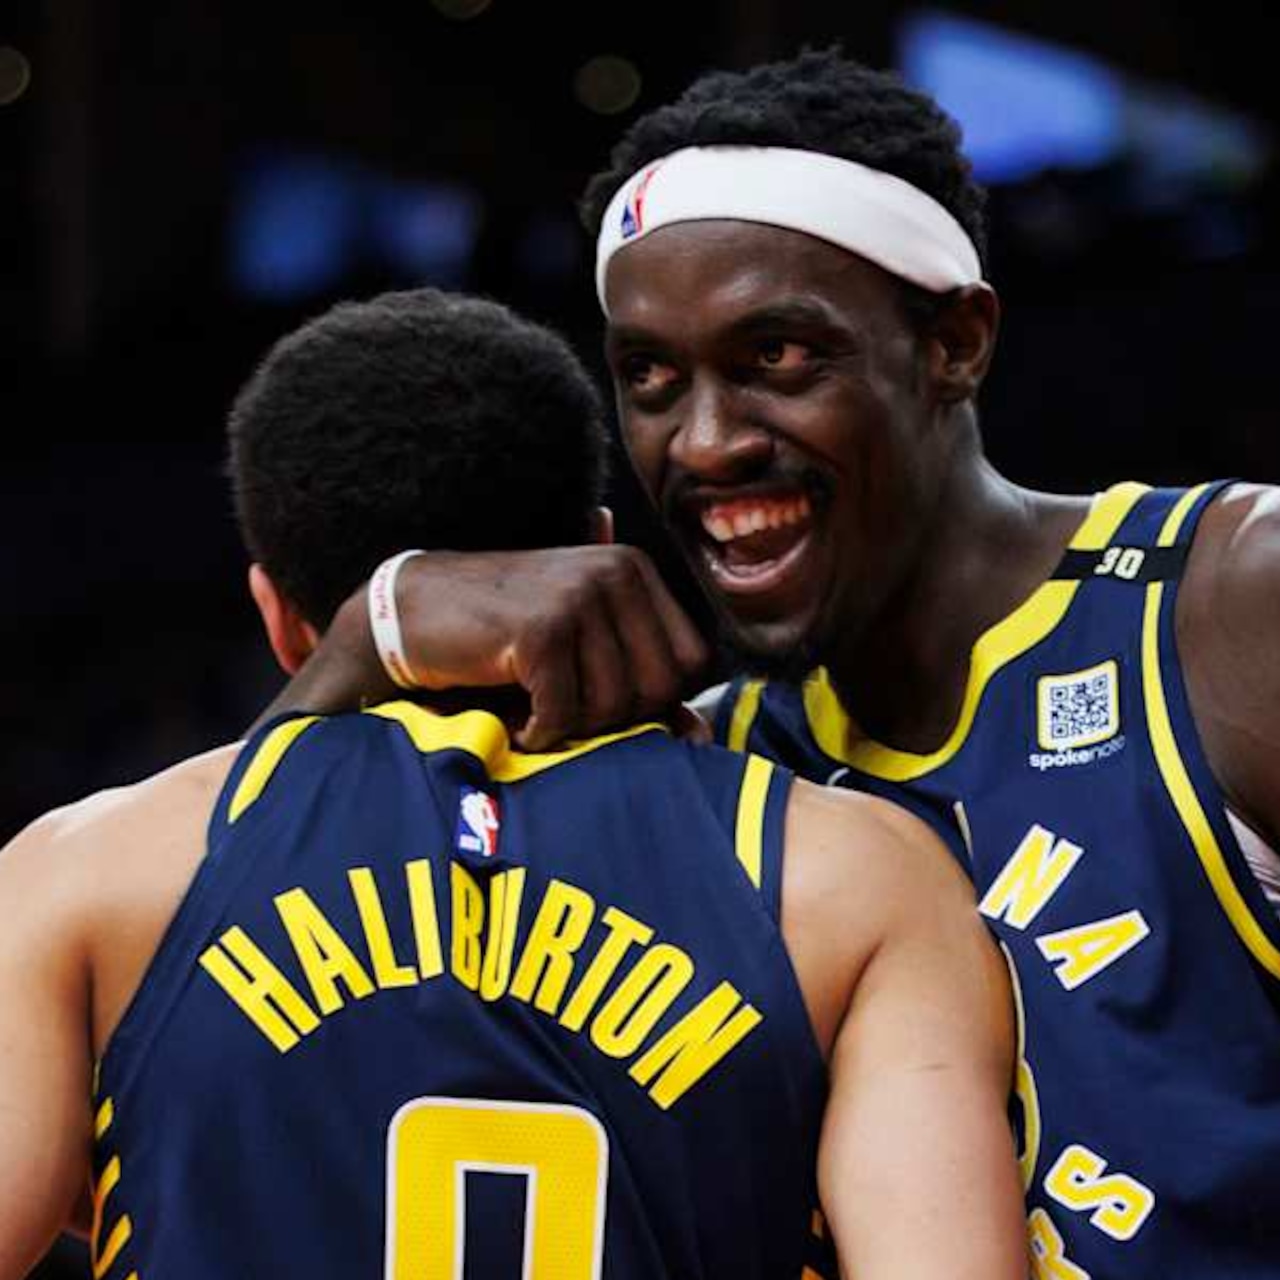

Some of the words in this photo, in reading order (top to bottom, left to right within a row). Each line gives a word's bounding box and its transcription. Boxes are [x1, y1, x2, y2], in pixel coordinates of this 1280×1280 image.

[1094, 546, 1145, 580] 30
[198, 858, 763, 1110] HALIBURTON
[965, 812, 1151, 991] NA
